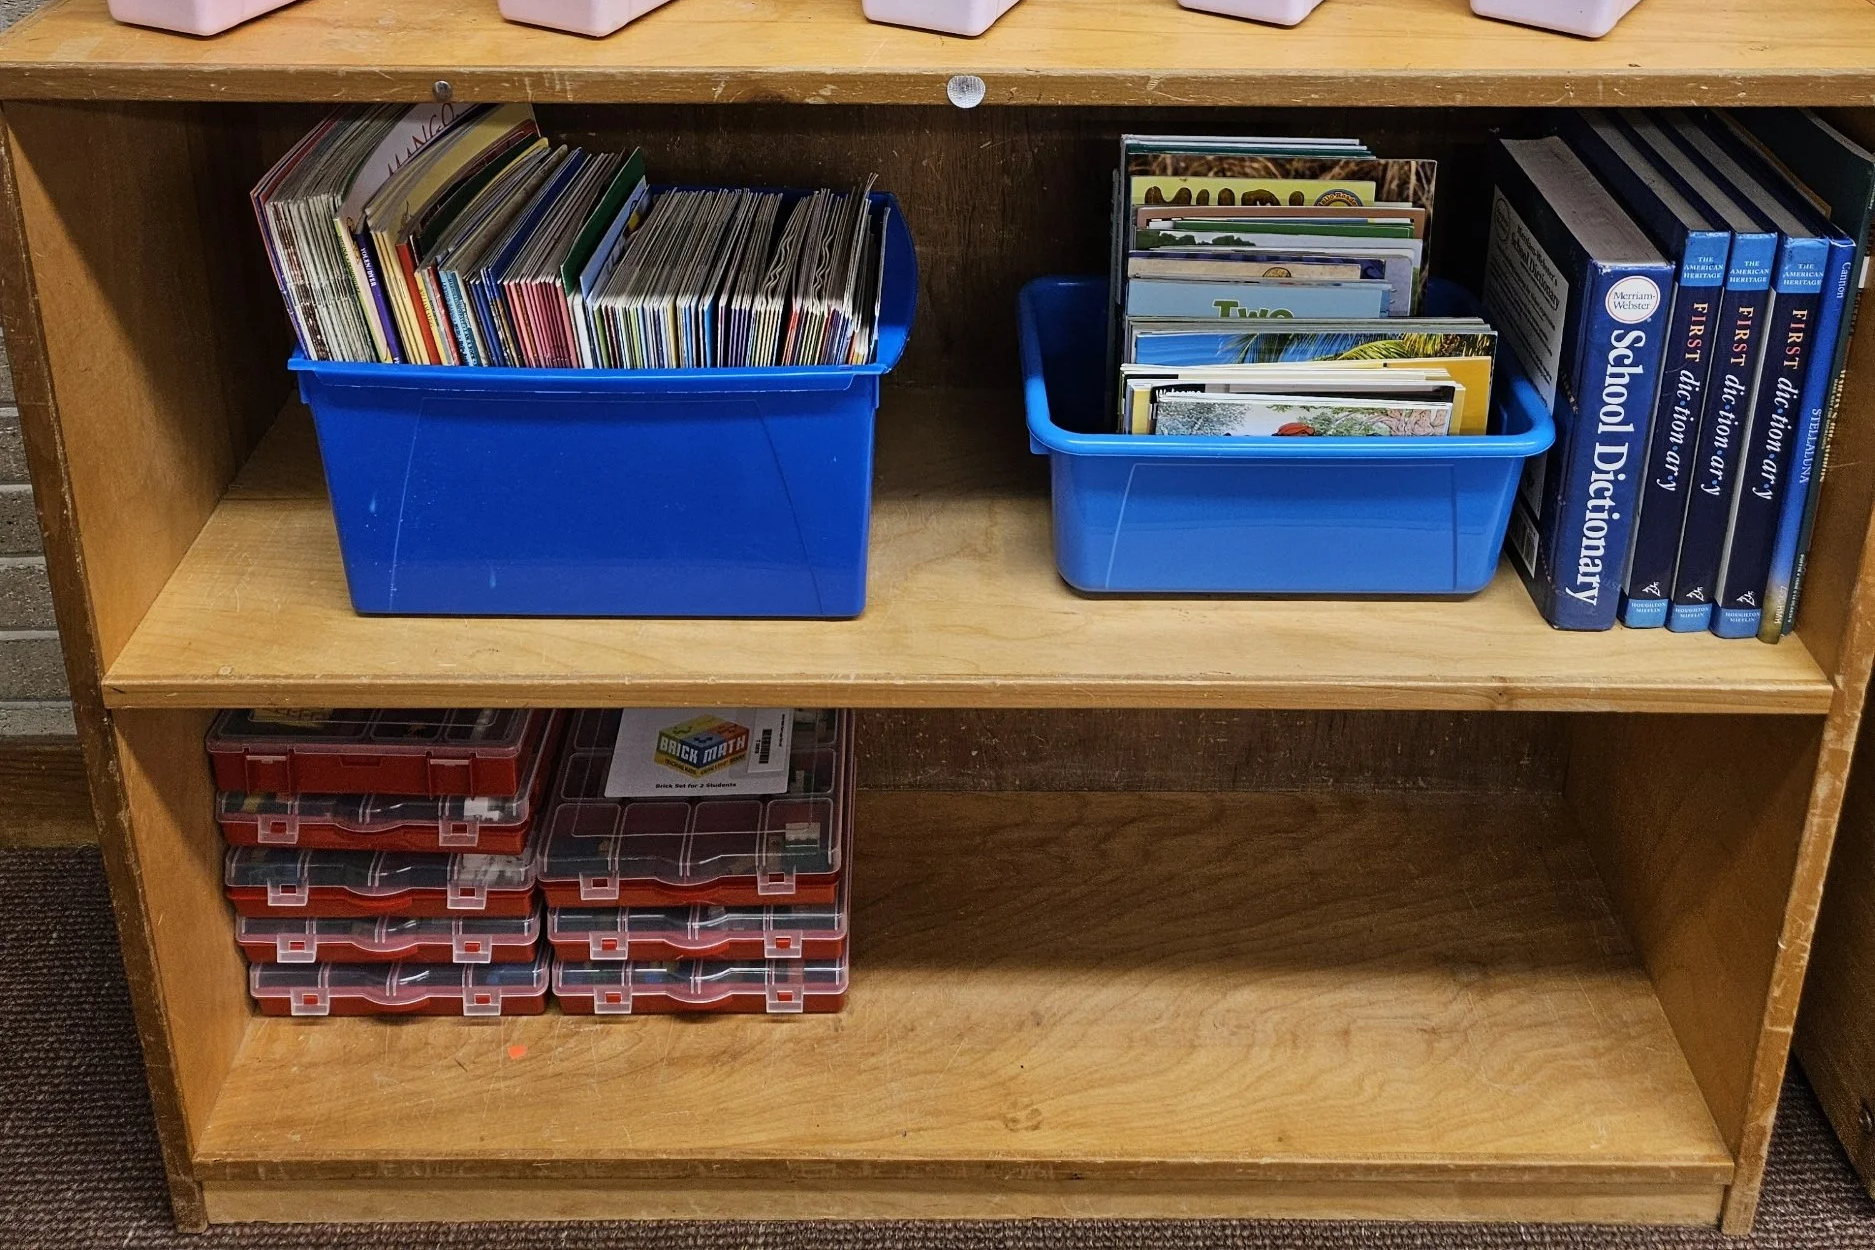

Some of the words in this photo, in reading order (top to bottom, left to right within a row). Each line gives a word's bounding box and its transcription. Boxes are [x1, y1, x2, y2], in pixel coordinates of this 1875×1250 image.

[1613, 291, 1656, 301] Merriam-
[1613, 300, 1651, 310] Webster
[1836, 261, 1852, 299] Cannon
[1685, 302, 1709, 363] FIRST
[1730, 306, 1755, 367] FIRST
[1783, 309, 1808, 370] FIRST
[1597, 329, 1646, 434] School
[1799, 408, 1822, 483] STELLALUNA
[1565, 442, 1629, 606] Dictionary
[660, 736, 698, 764] BRICK
[702, 735, 746, 764] MATH
